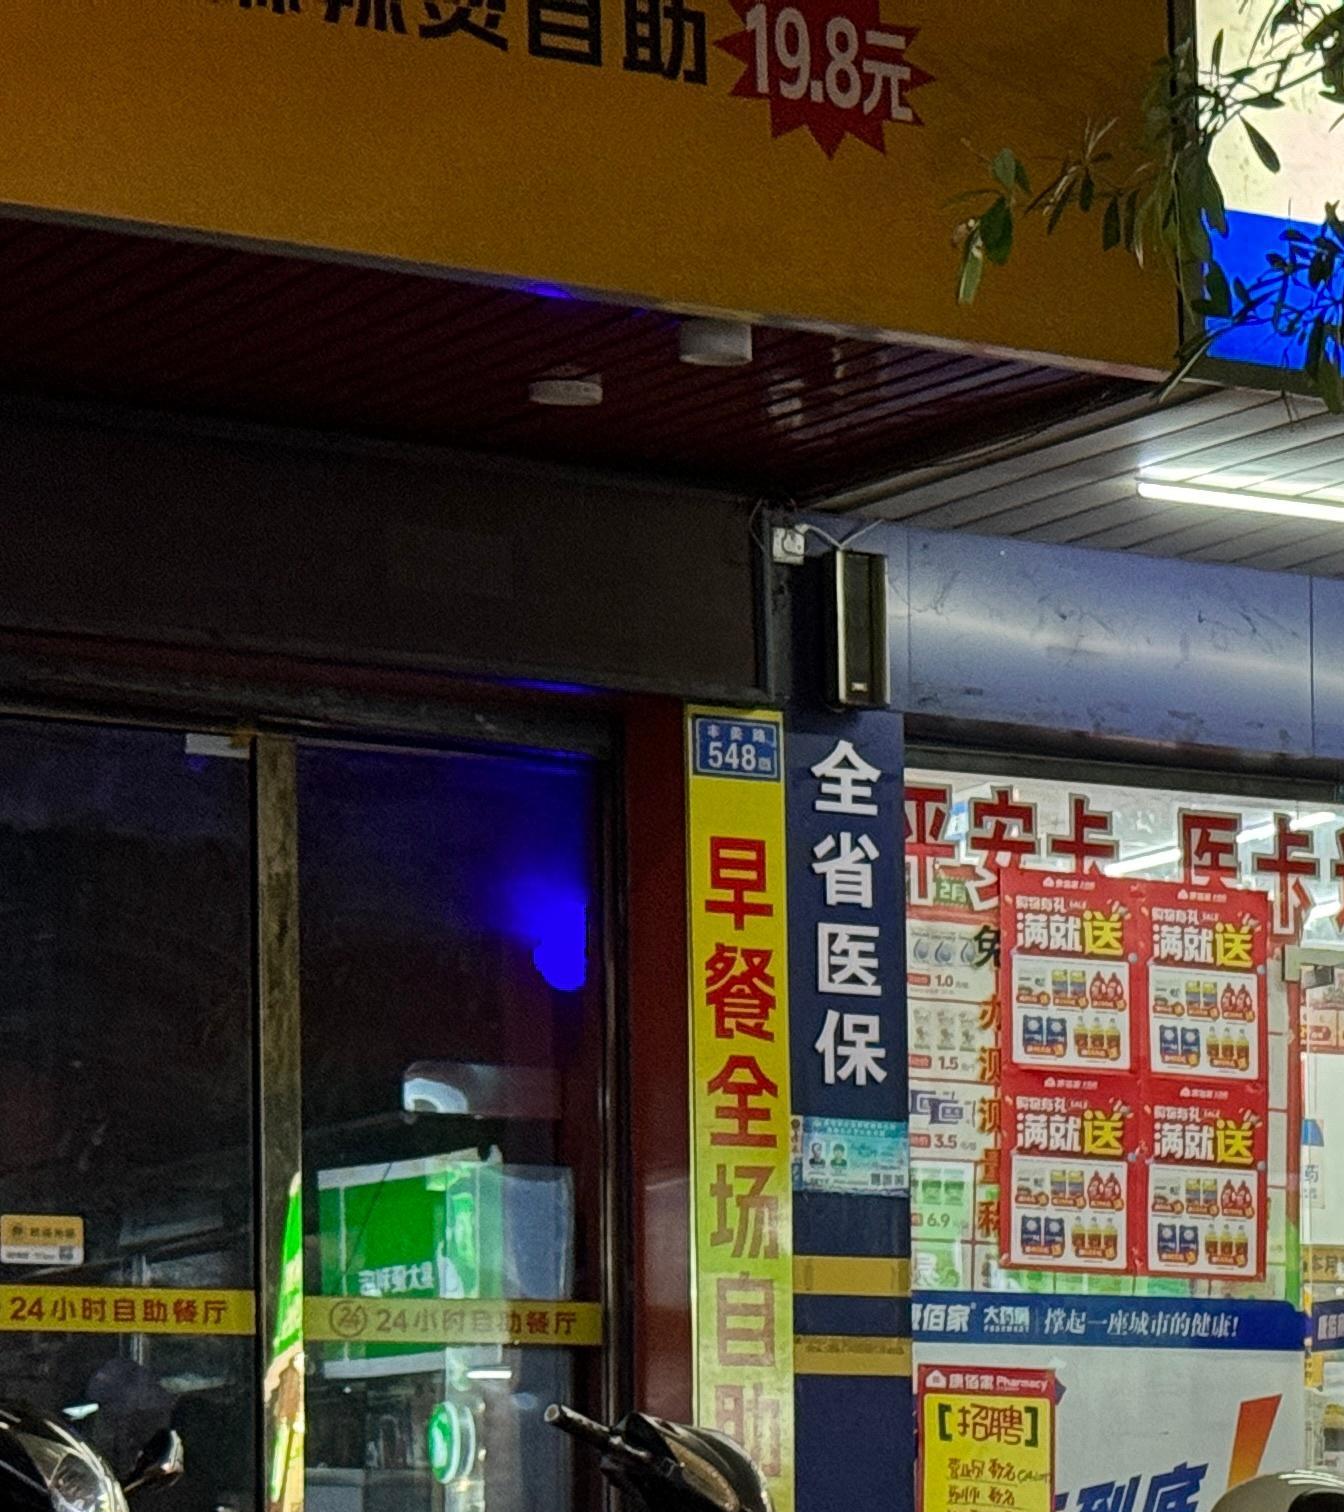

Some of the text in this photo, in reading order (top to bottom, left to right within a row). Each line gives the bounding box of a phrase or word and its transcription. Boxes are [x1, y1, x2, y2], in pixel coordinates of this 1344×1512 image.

[746, 3, 913, 122] 19.8元
[904, 783, 1119, 911] 平安卡
[811, 739, 887, 1087] 全省医保
[1016, 911, 1124, 956] 满就送
[1153, 922, 1253, 968] 满就送
[1016, 1110, 1124, 1156] 满就送
[1154, 1119, 1254, 1164] 满就送
[10, 1296, 228, 1324] 24小时自助餐厅
[996, 1376, 1048, 1391] Pharmacy
